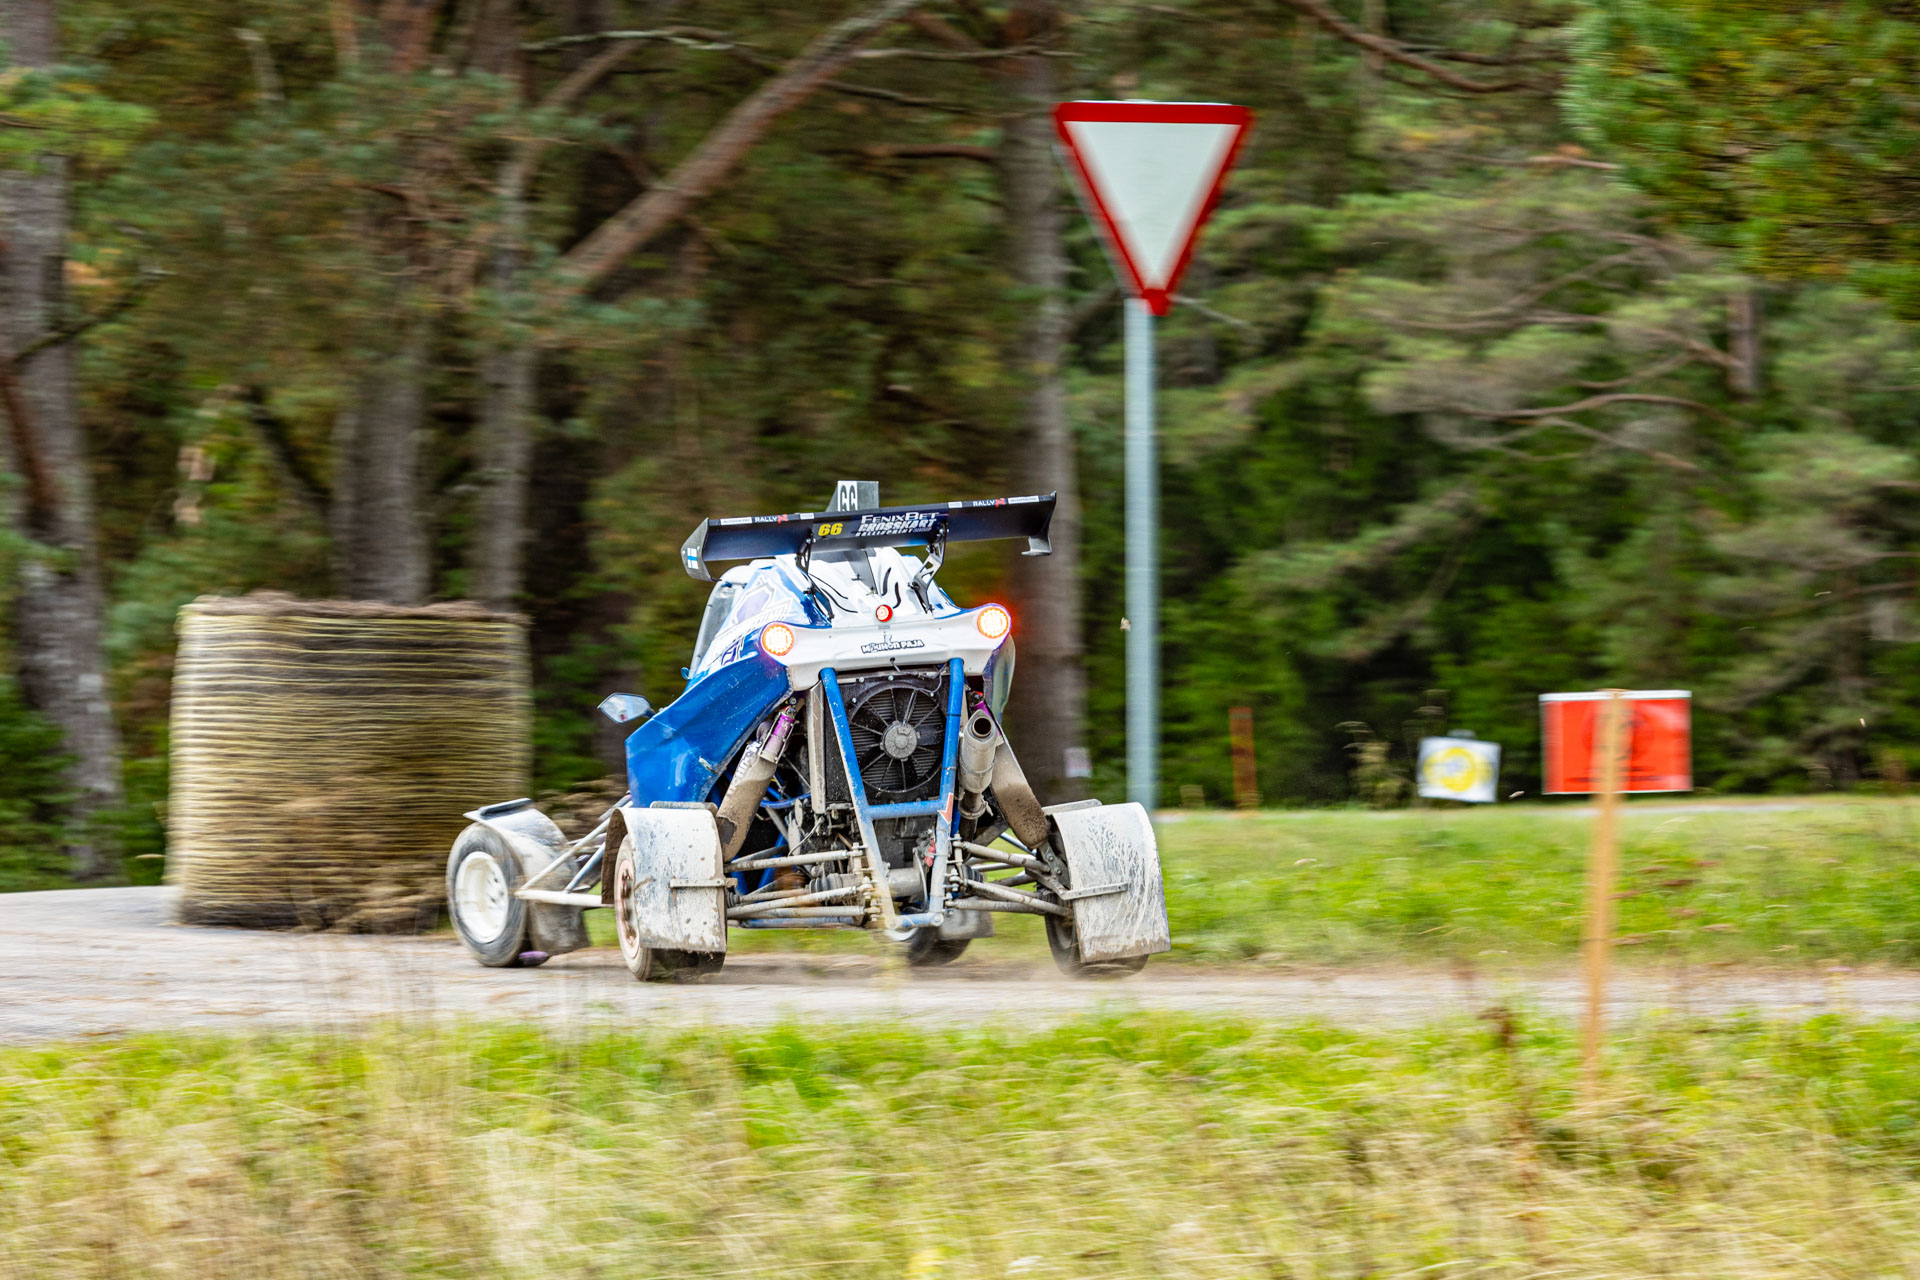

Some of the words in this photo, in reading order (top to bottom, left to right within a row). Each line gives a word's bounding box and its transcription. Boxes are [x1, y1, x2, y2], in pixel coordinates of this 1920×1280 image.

[840, 485, 856, 511] 66
[818, 522, 843, 536] 66
[858, 519, 937, 532] CROSSKART
[900, 640, 924, 649] PAJA
